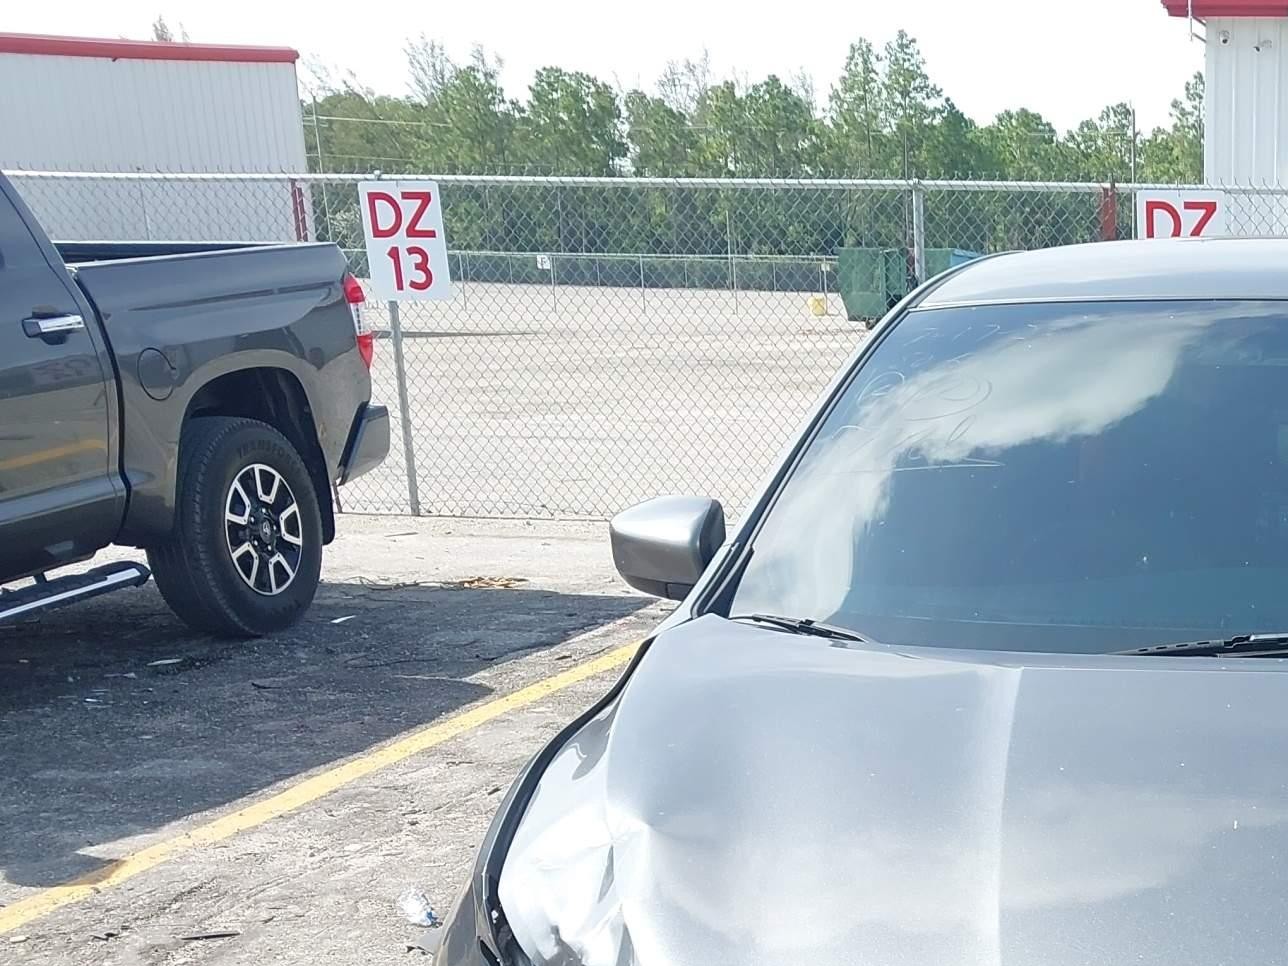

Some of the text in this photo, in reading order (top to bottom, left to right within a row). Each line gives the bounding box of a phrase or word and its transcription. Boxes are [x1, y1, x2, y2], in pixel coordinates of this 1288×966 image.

[366, 192, 437, 238] DZ
[1145, 201, 1217, 238] DZ
[386, 246, 433, 291] 13
